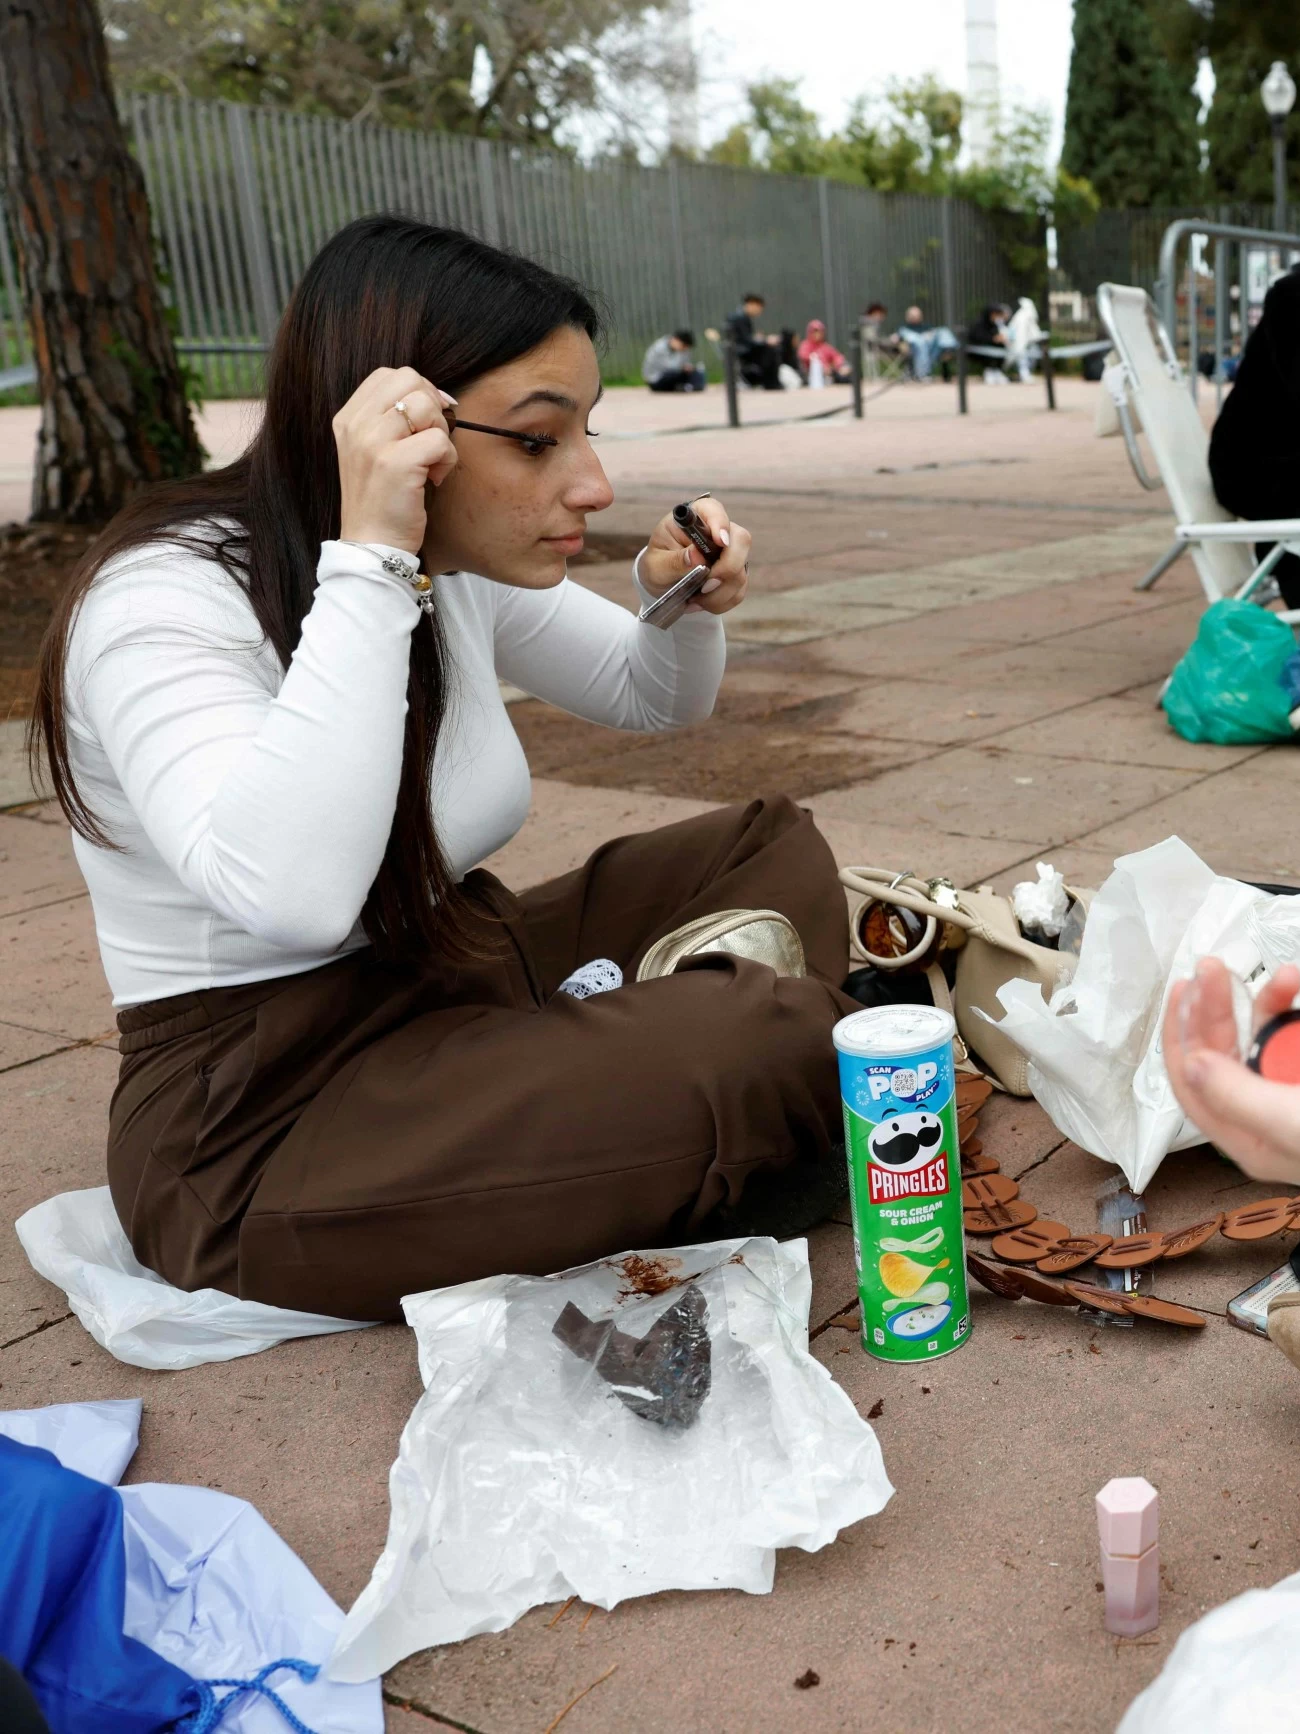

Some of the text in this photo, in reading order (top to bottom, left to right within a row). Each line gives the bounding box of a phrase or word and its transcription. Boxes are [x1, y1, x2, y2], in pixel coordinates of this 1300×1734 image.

[869, 1066, 892, 1075] SCAN
[871, 1158, 946, 1200] PRINGLES
[879, 1201, 943, 1218] SOUR CREAM
[890, 1213, 934, 1226] & ONION
